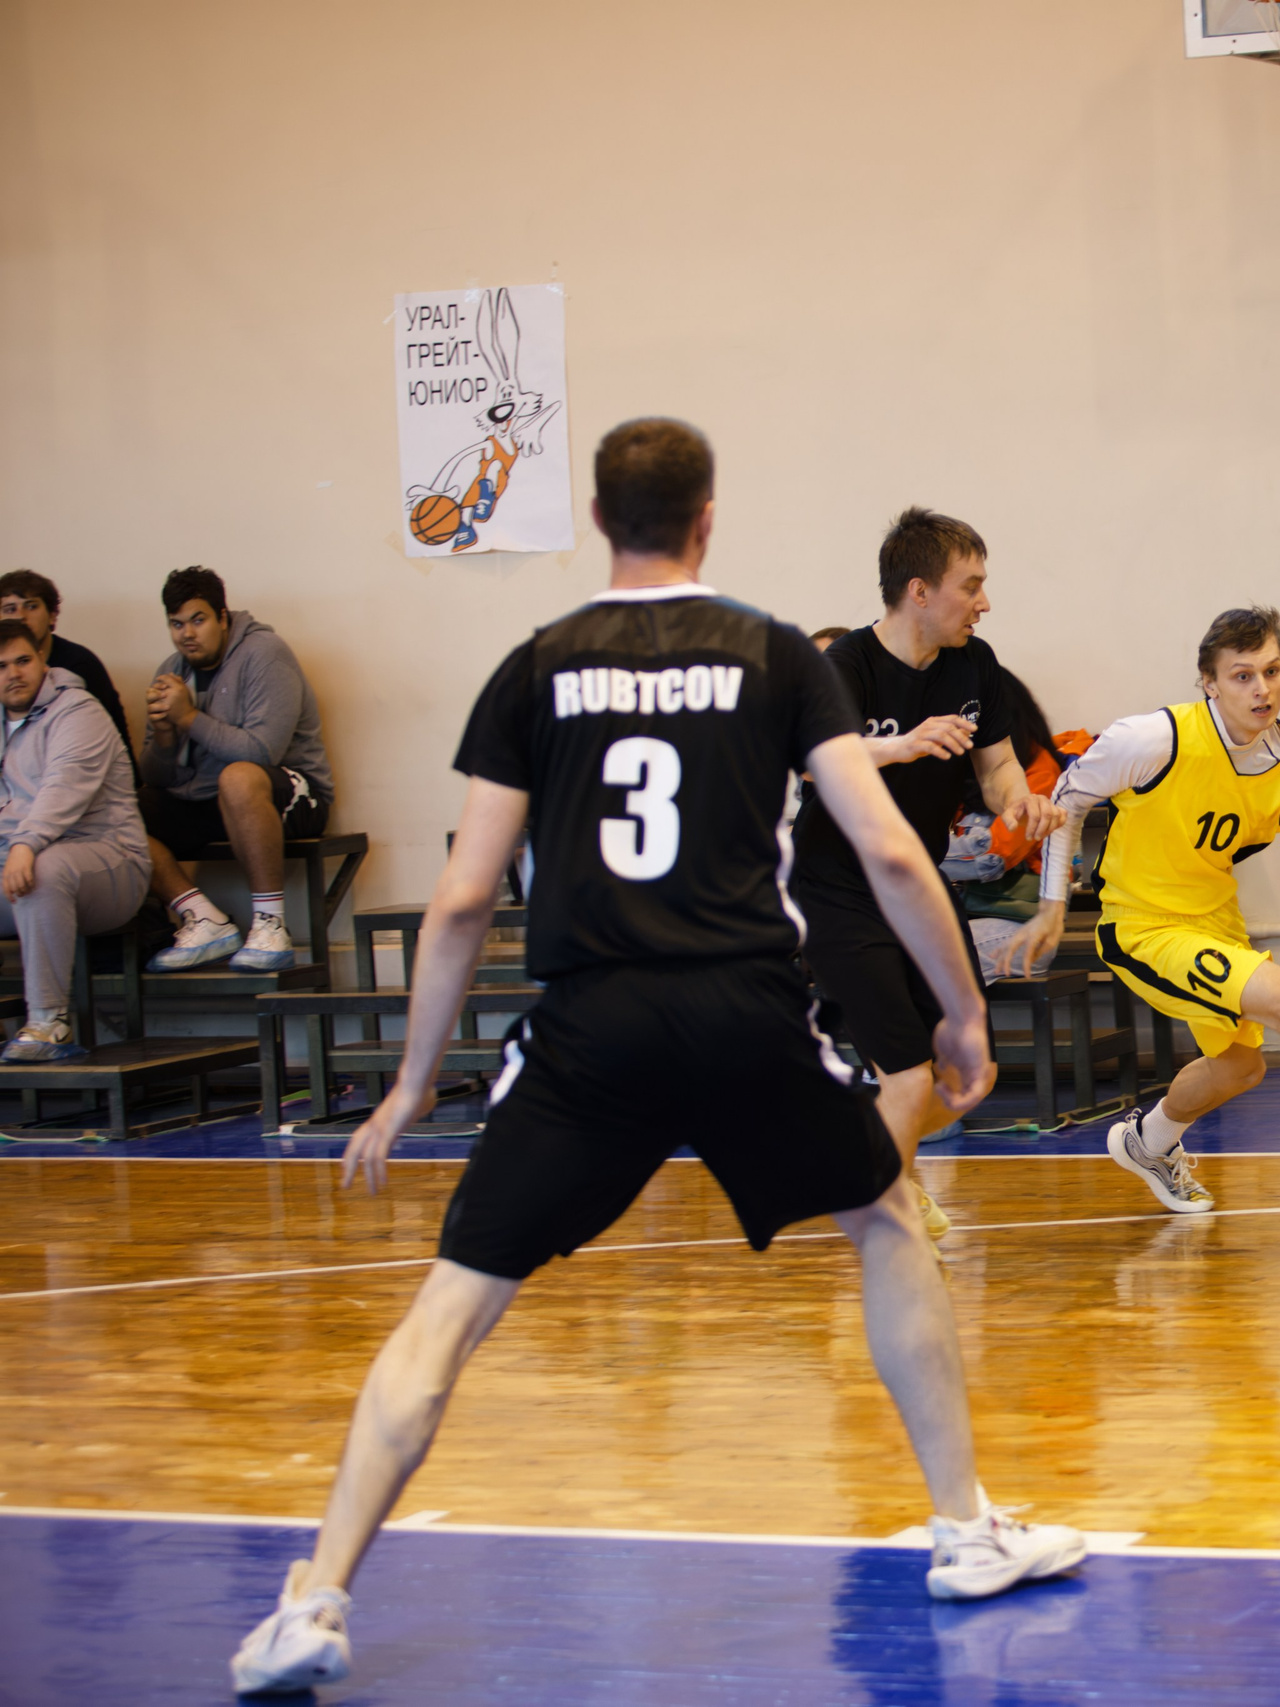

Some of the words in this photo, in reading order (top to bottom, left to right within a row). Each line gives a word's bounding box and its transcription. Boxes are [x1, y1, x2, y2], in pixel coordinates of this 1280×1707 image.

[405, 303, 465, 331] УРАЛ-
[407, 337, 480, 369] ГРЕЙТ-
[408, 377, 488, 406] ЮНИОР
[553, 664, 744, 719] RUBTCOV
[599, 736, 682, 881] 3
[1194, 811, 1240, 852] 10
[1186, 948, 1232, 999] 10
